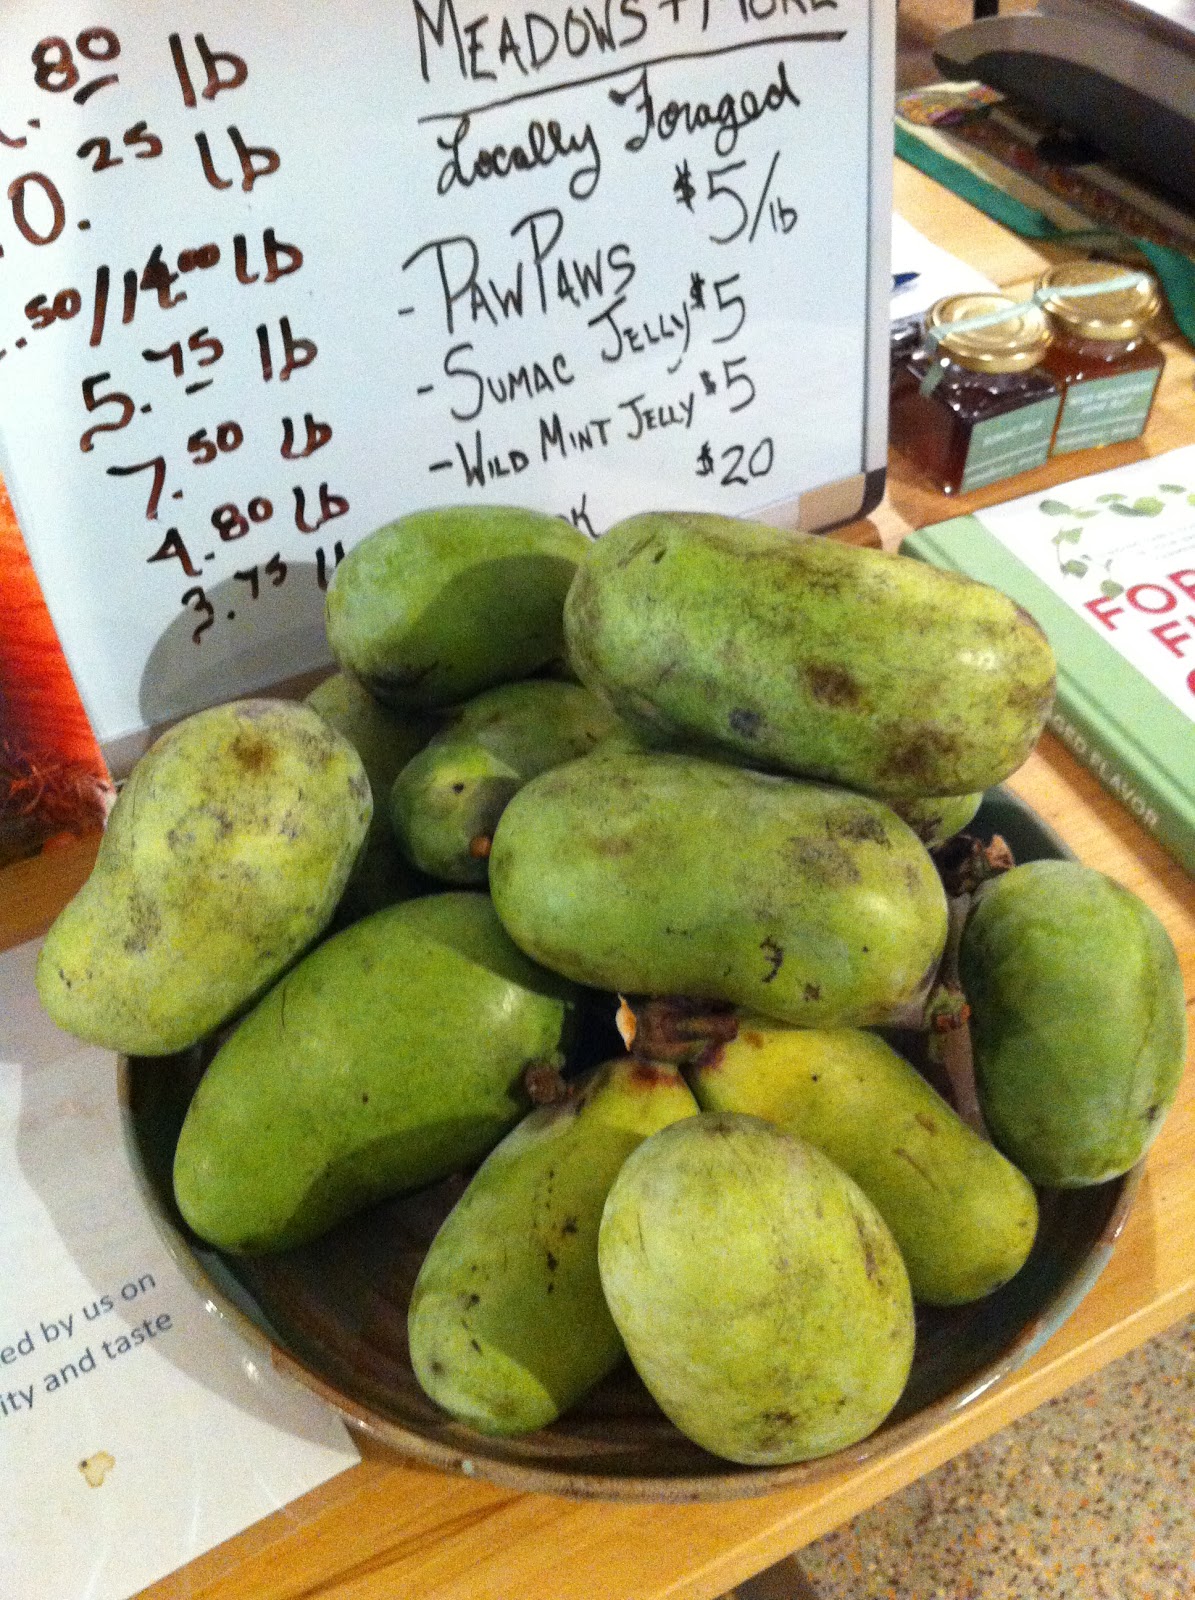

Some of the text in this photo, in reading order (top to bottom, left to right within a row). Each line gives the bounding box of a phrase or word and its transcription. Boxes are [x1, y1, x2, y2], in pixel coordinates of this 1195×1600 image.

[414, 0, 649, 83] MEADOWS
[437, 62, 801, 200] Locally Foraged
[443, 342, 575, 421] SUMAC
[539, 413, 611, 461] MINT
[695, 437, 775, 486] $20
[40, 1313, 73, 1343] by
[82, 1294, 114, 1321] us
[120, 1272, 156, 1302] on
[43, 1346, 97, 1393] and
[101, 1312, 173, 1360] taste
